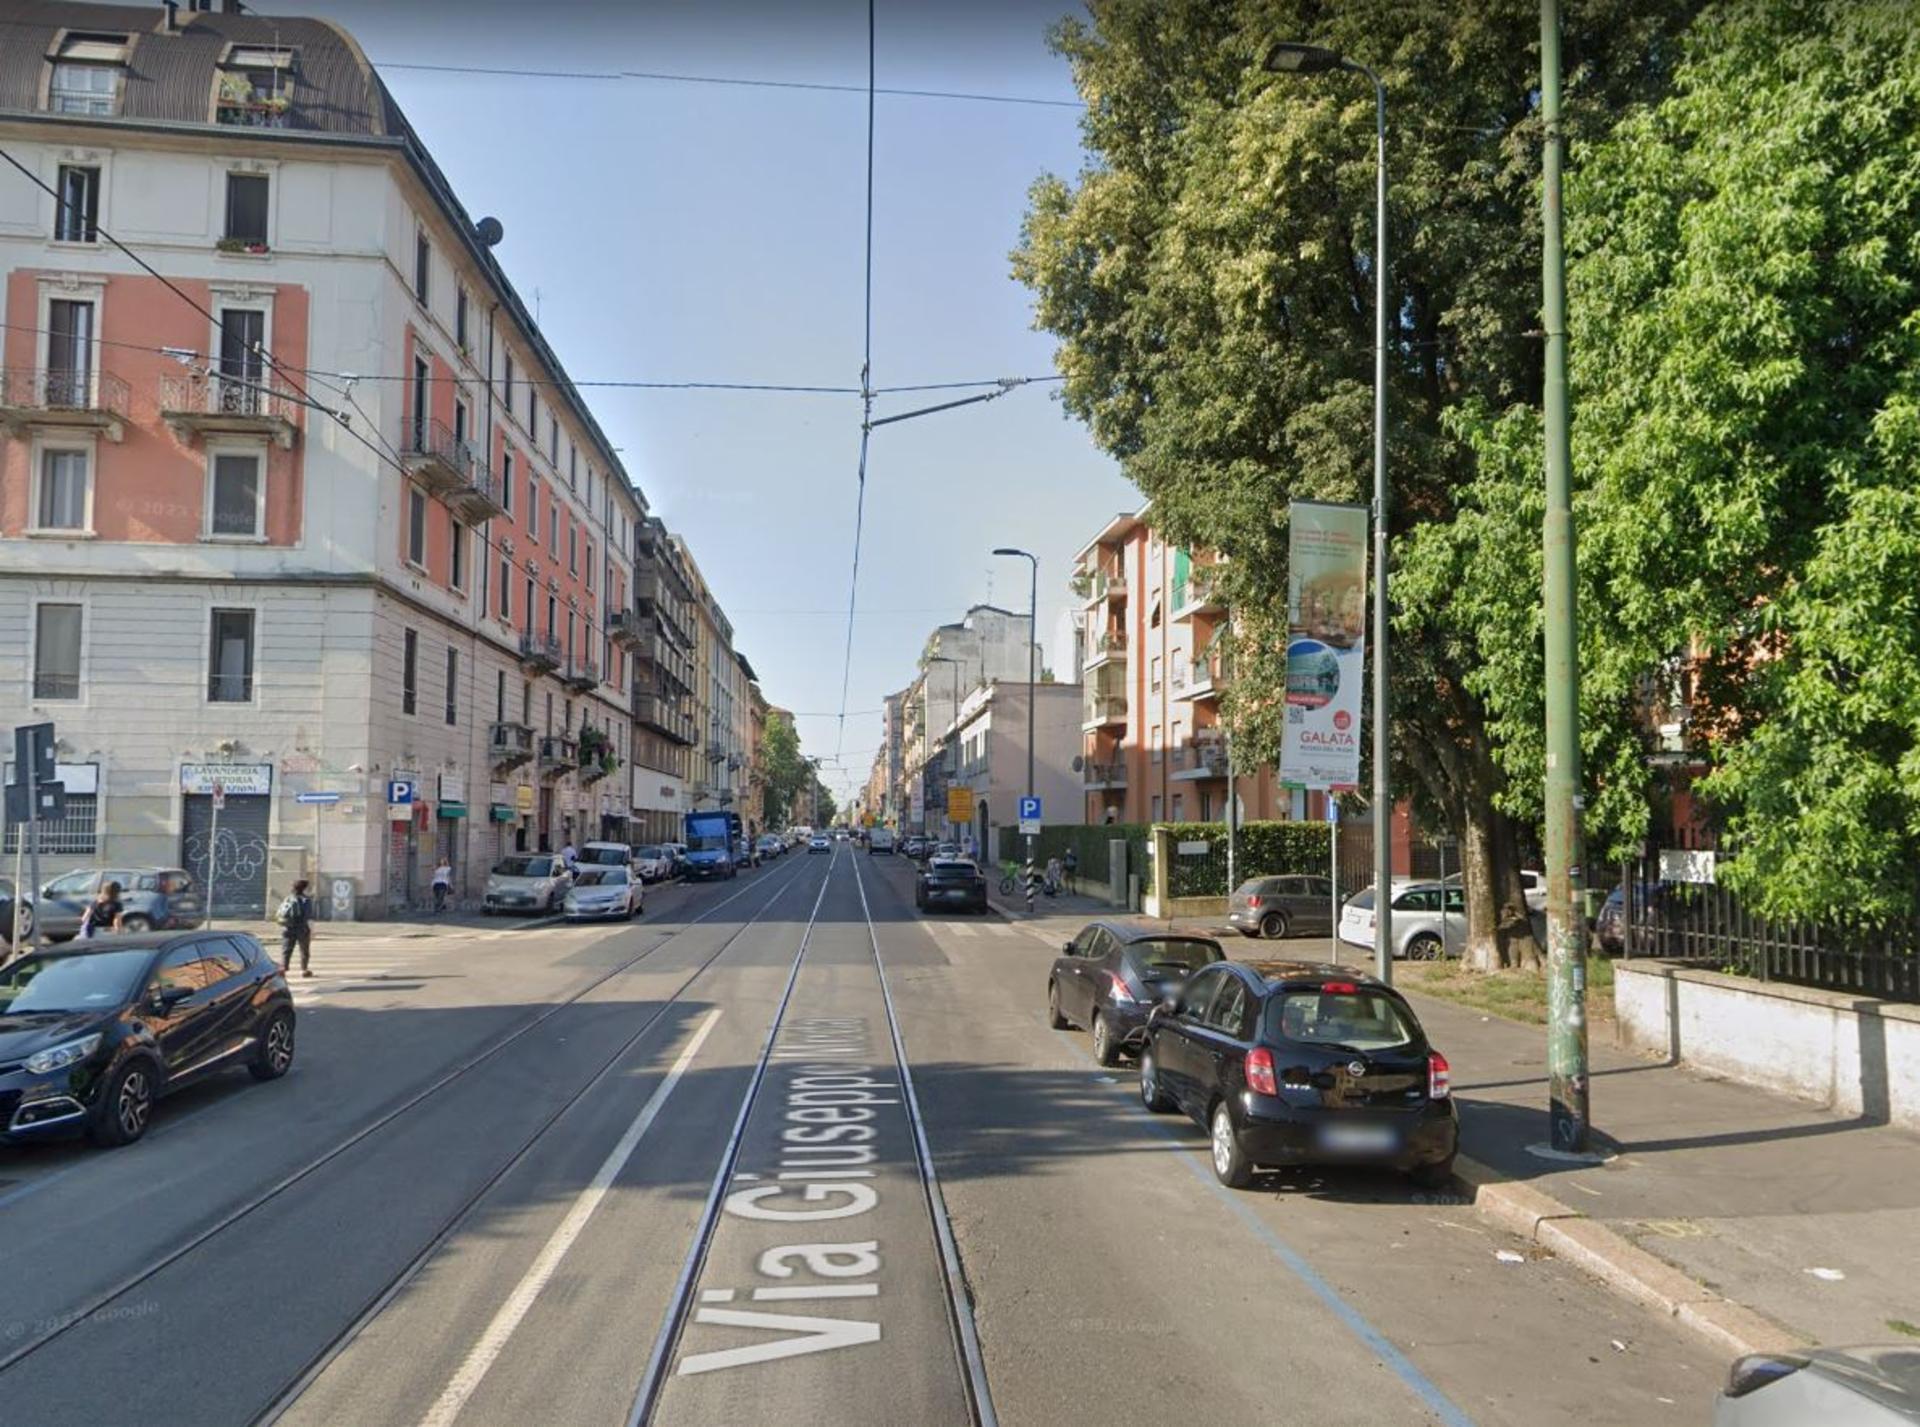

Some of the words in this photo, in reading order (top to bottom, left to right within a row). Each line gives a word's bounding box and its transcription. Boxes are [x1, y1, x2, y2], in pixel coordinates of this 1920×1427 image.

[1300, 730, 1355, 746] GALATA
[194, 767, 258, 775] LAVANDERIA
[201, 776, 254, 784] SARTORIA
[198, 784, 257, 792] RIPAZIONI
[392, 783, 410, 802] P
[1024, 800, 1037, 817] P
